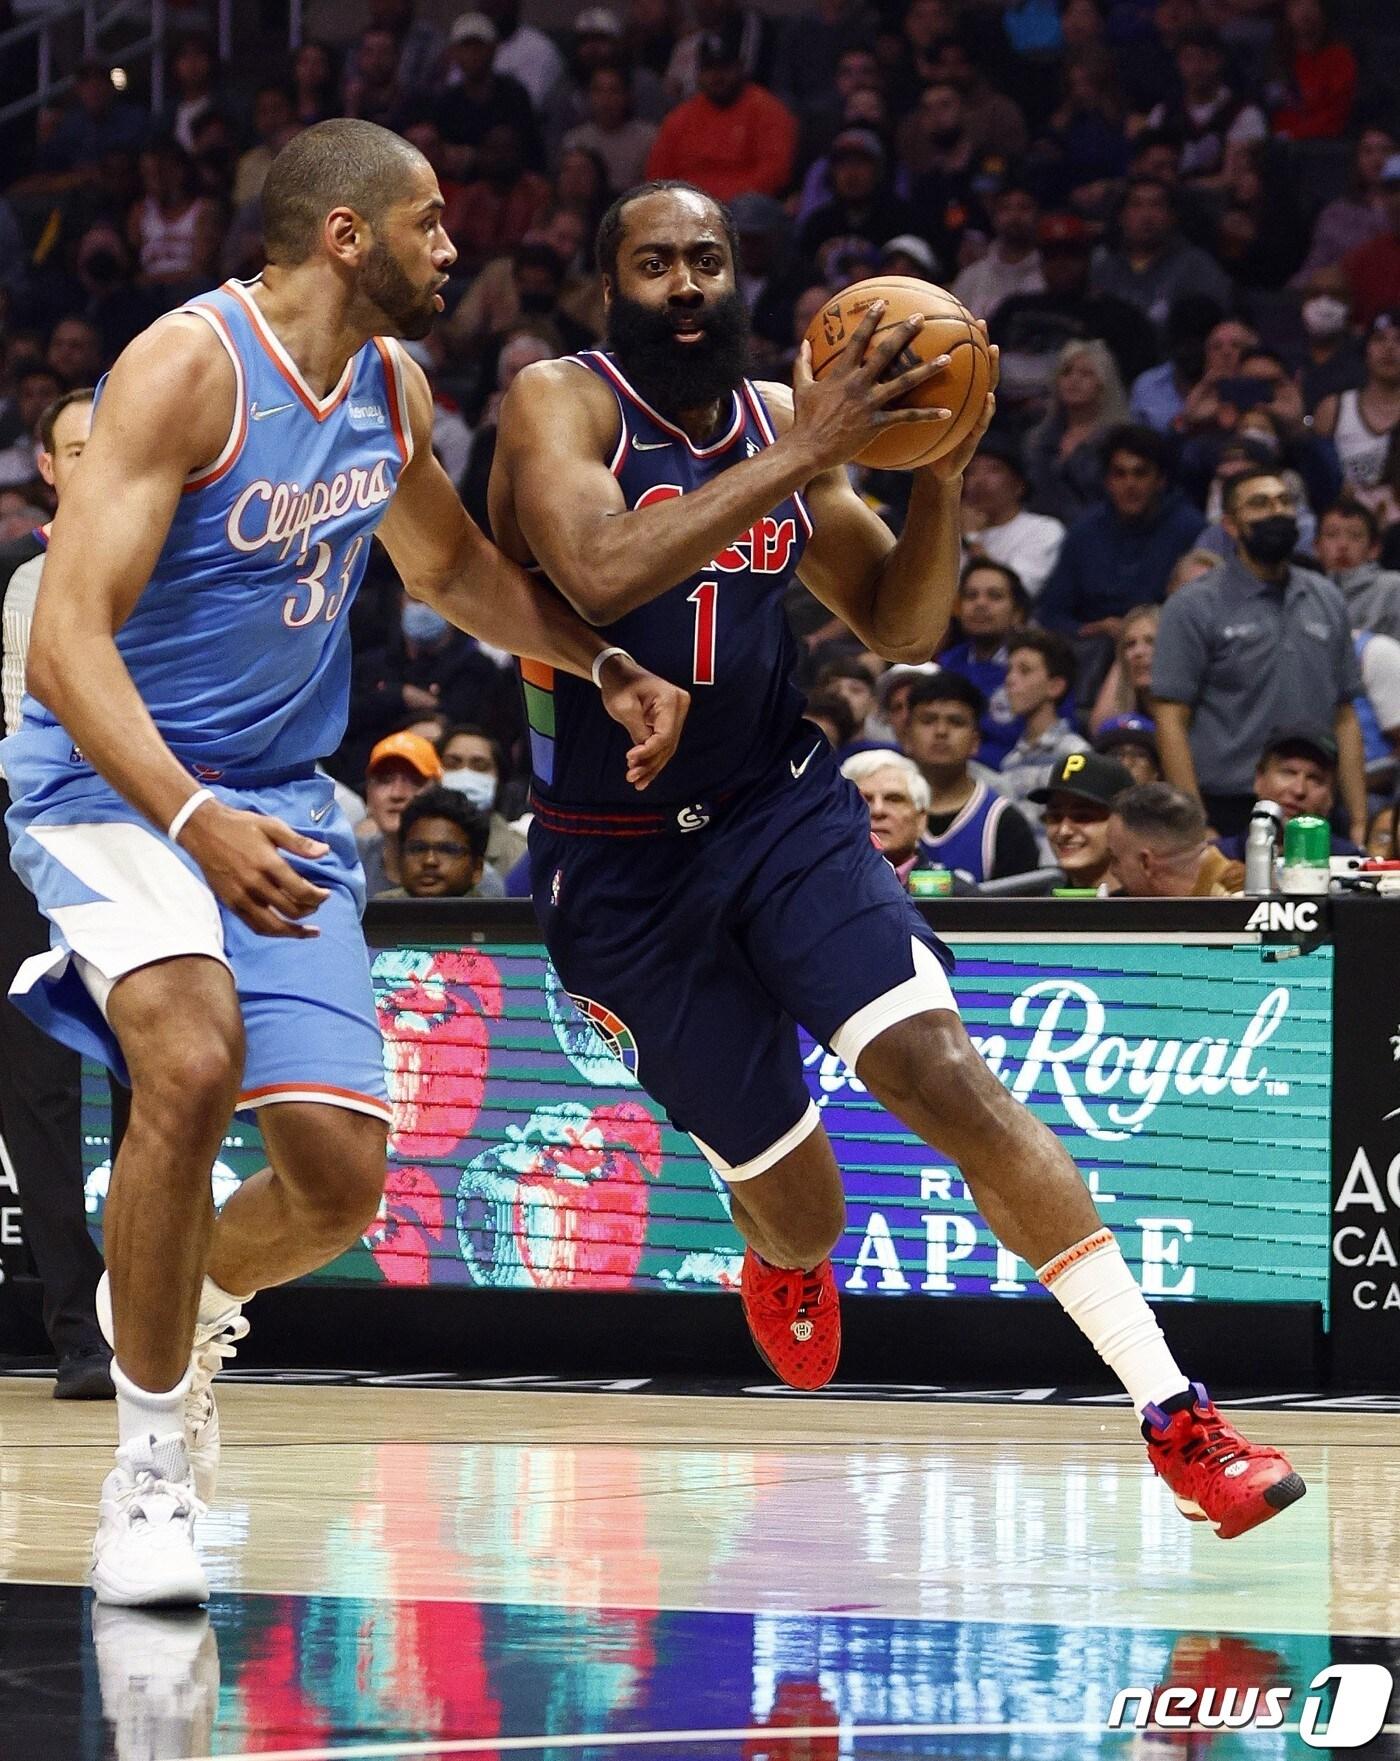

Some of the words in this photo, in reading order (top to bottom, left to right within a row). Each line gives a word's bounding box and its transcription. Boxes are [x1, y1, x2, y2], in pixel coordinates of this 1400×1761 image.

[226, 459, 391, 560] Clippers
[283, 535, 363, 628] 33
[687, 582, 718, 685] 1
[1062, 754, 1087, 781] P
[1244, 901, 1319, 932] ANC
[1009, 979, 1290, 1142] Royal
